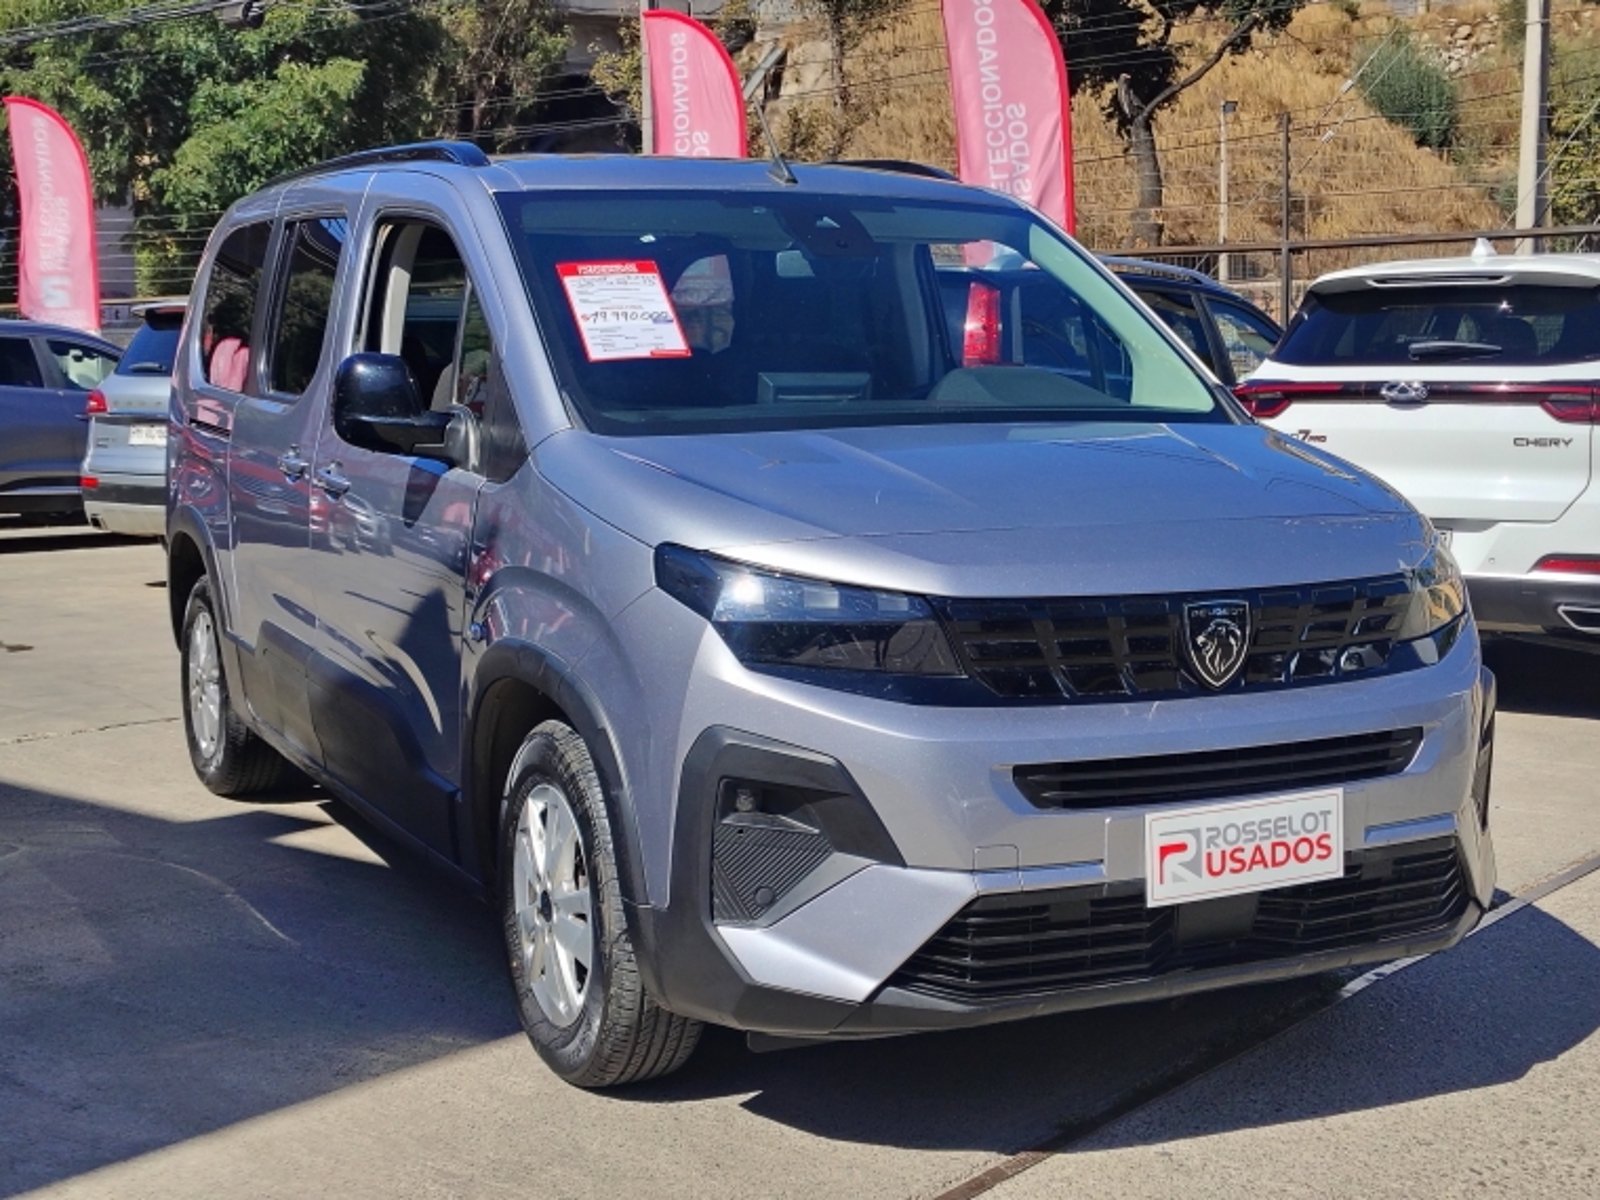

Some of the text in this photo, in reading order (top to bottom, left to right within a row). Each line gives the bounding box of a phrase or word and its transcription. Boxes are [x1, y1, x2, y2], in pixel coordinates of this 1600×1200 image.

[1513, 437, 1573, 447] CHERY
[1206, 810, 1331, 849] ROSSELOT
[1206, 833, 1332, 877] USADOS
